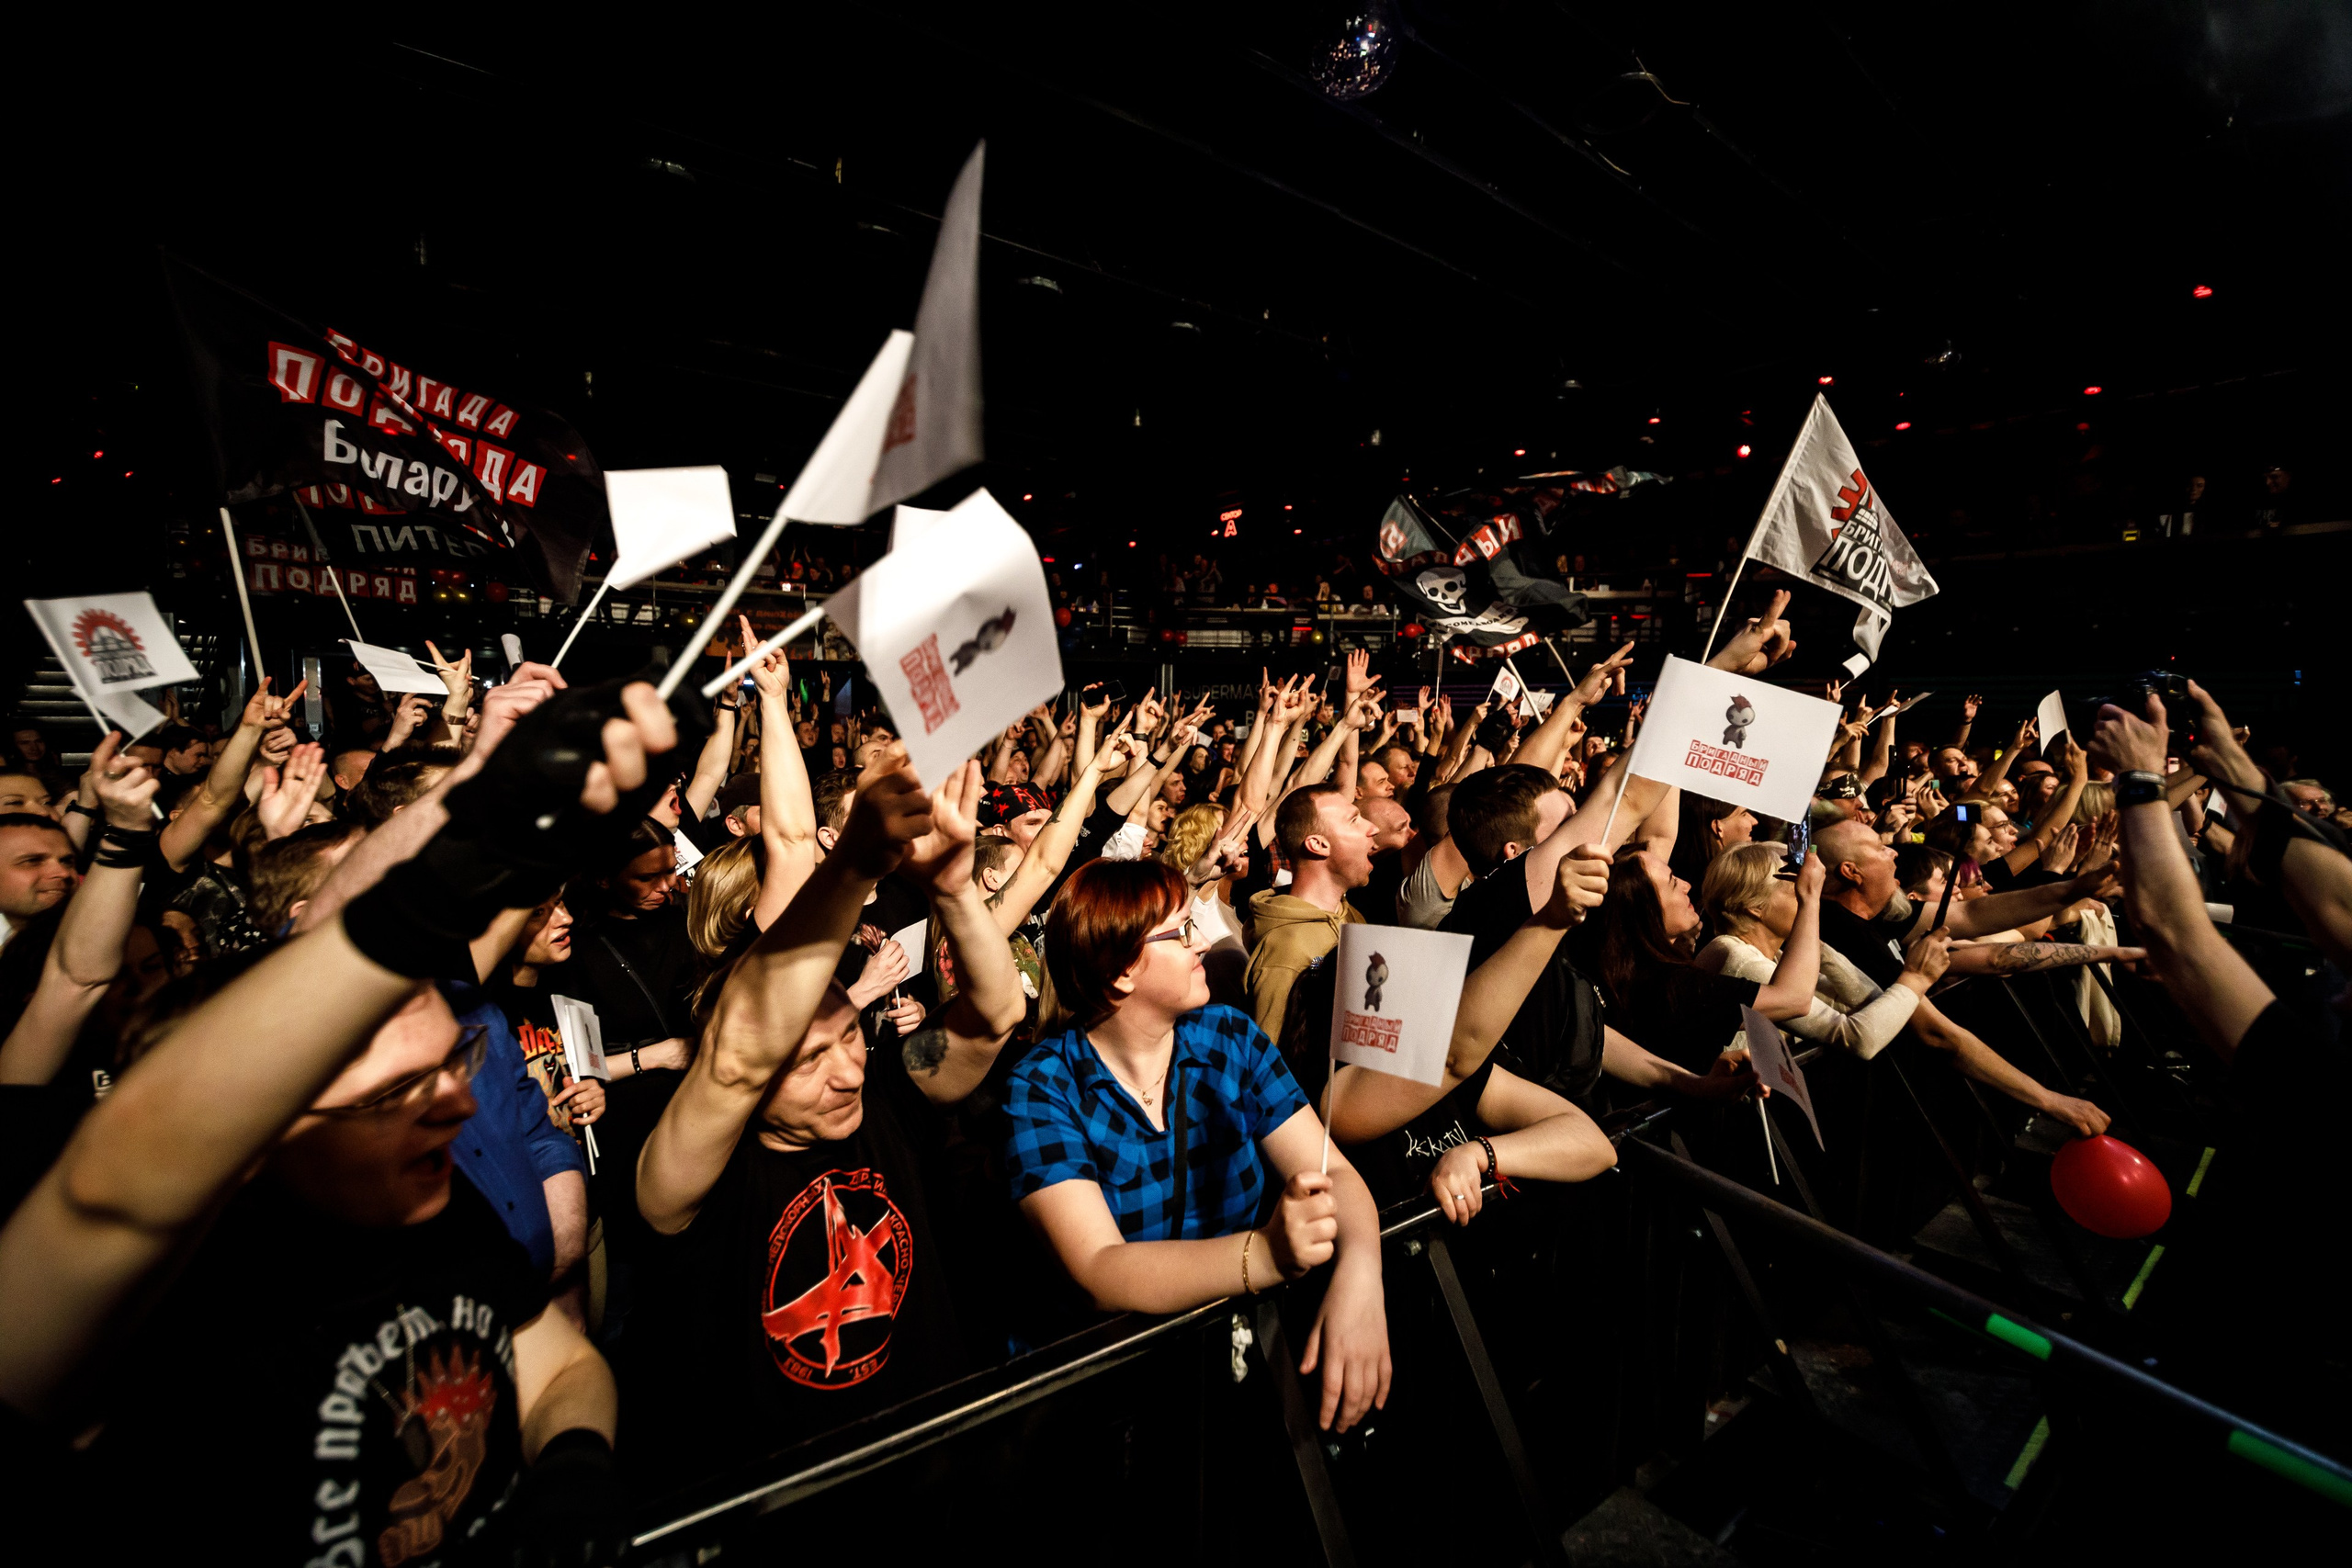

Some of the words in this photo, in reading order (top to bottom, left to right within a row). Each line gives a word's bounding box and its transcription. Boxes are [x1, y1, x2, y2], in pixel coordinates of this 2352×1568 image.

[251, 562, 417, 604] ПОДРЯД
[1685, 751, 1763, 786] ПОДРЯД
[1690, 739, 1769, 772] БРИГАДНЫЙ
